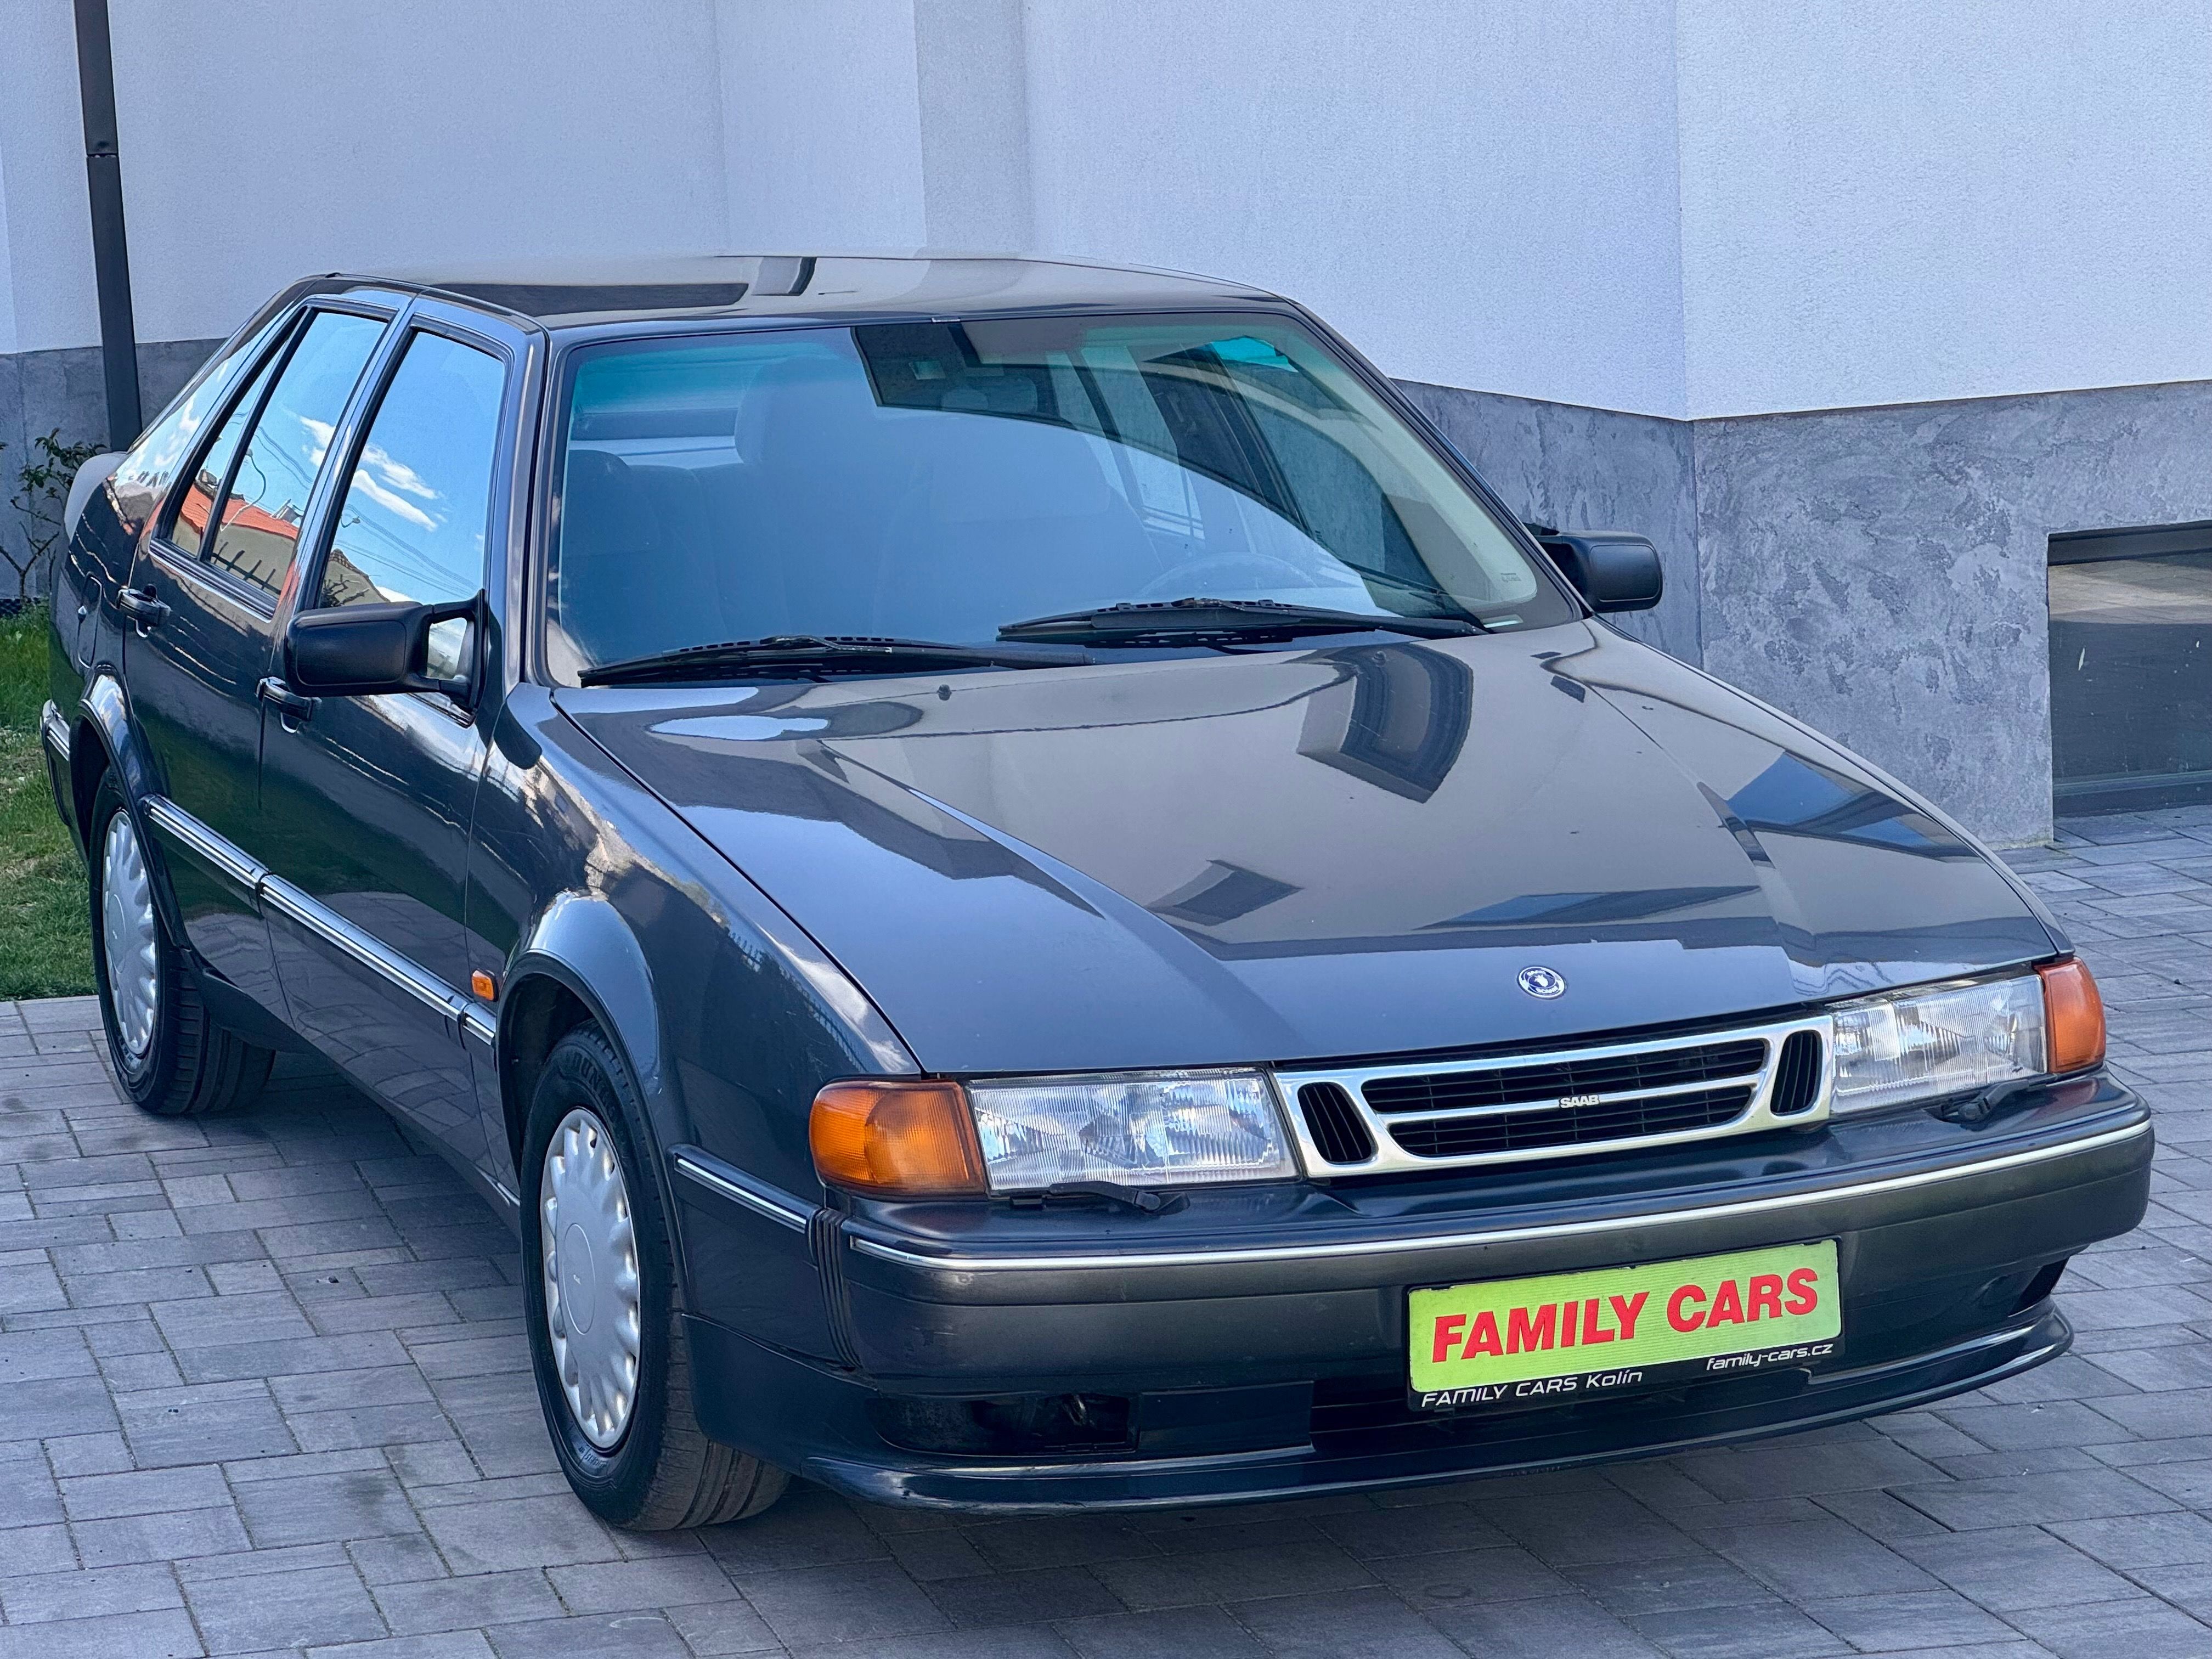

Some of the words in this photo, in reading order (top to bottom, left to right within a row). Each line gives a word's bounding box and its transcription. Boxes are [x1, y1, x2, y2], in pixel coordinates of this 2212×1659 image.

[1560, 1094, 1600, 1109] SAAB
[1432, 1292, 1649, 1363] FAMILY
[1666, 1267, 1818, 1333] CARS
[1706, 1343, 1834, 1371] family-cars.cz
[1421, 1384, 1509, 1408] FAMILY
[1515, 1376, 1578, 1397] CARS
[1585, 1369, 1643, 1389] Kolín
